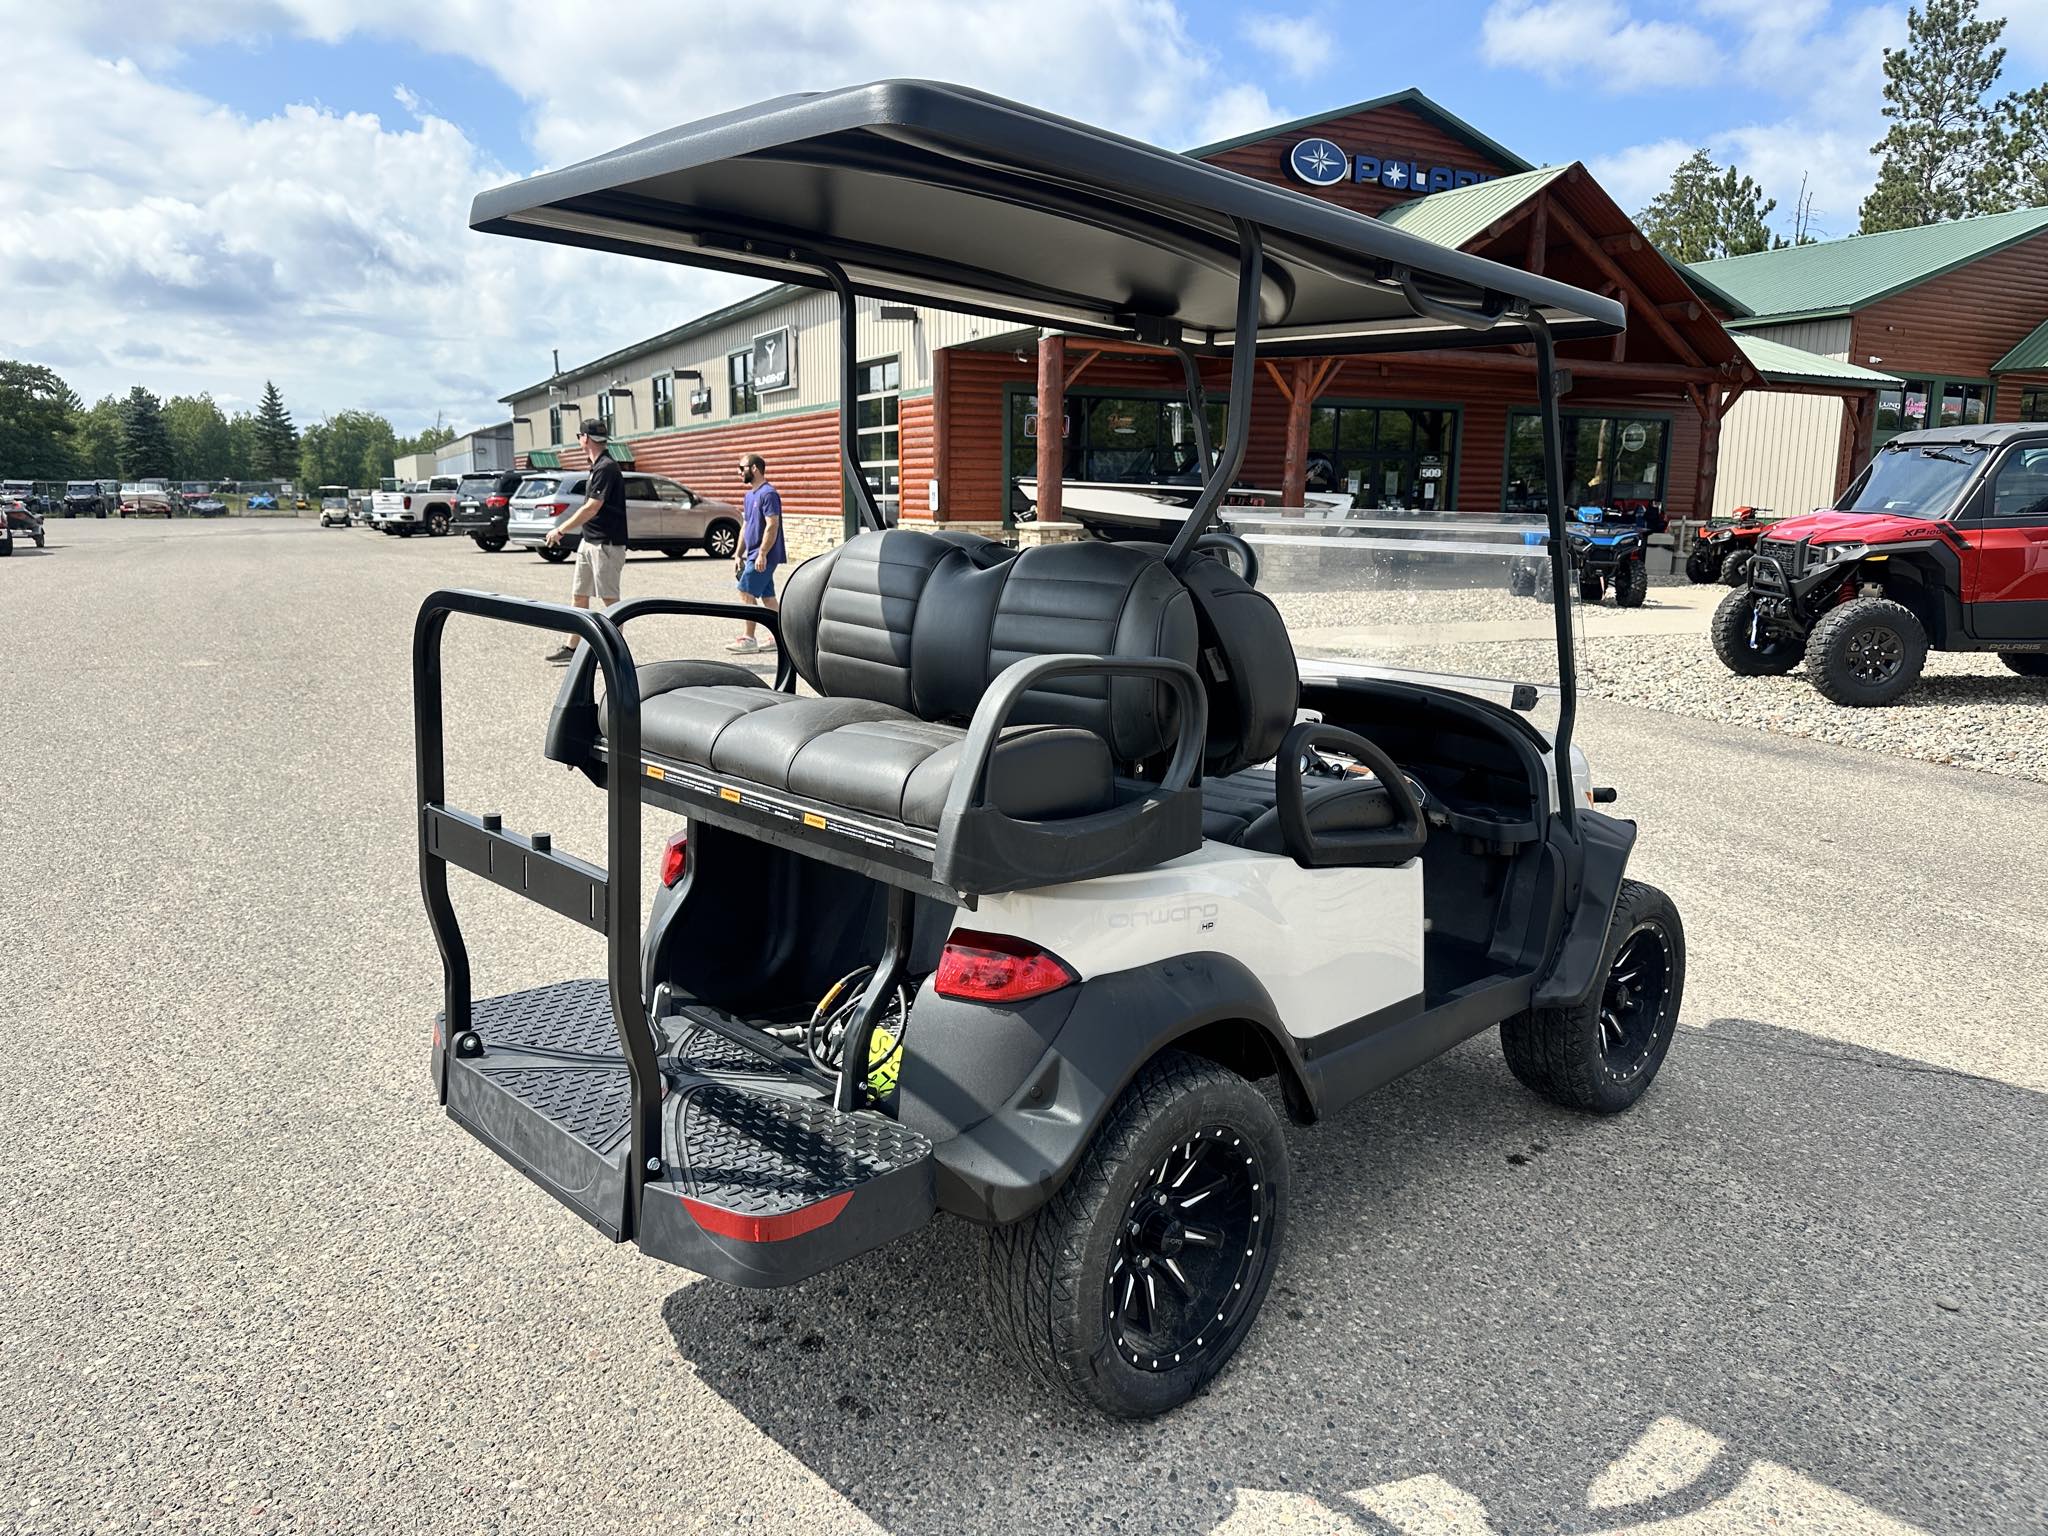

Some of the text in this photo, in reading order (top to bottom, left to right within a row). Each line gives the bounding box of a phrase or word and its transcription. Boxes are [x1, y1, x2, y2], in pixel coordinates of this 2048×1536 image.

[1355, 153, 1500, 194] POLAR
[1422, 468, 1441, 478] 509
[1903, 528, 1926, 538] XP
[1202, 922, 1214, 931] HP
